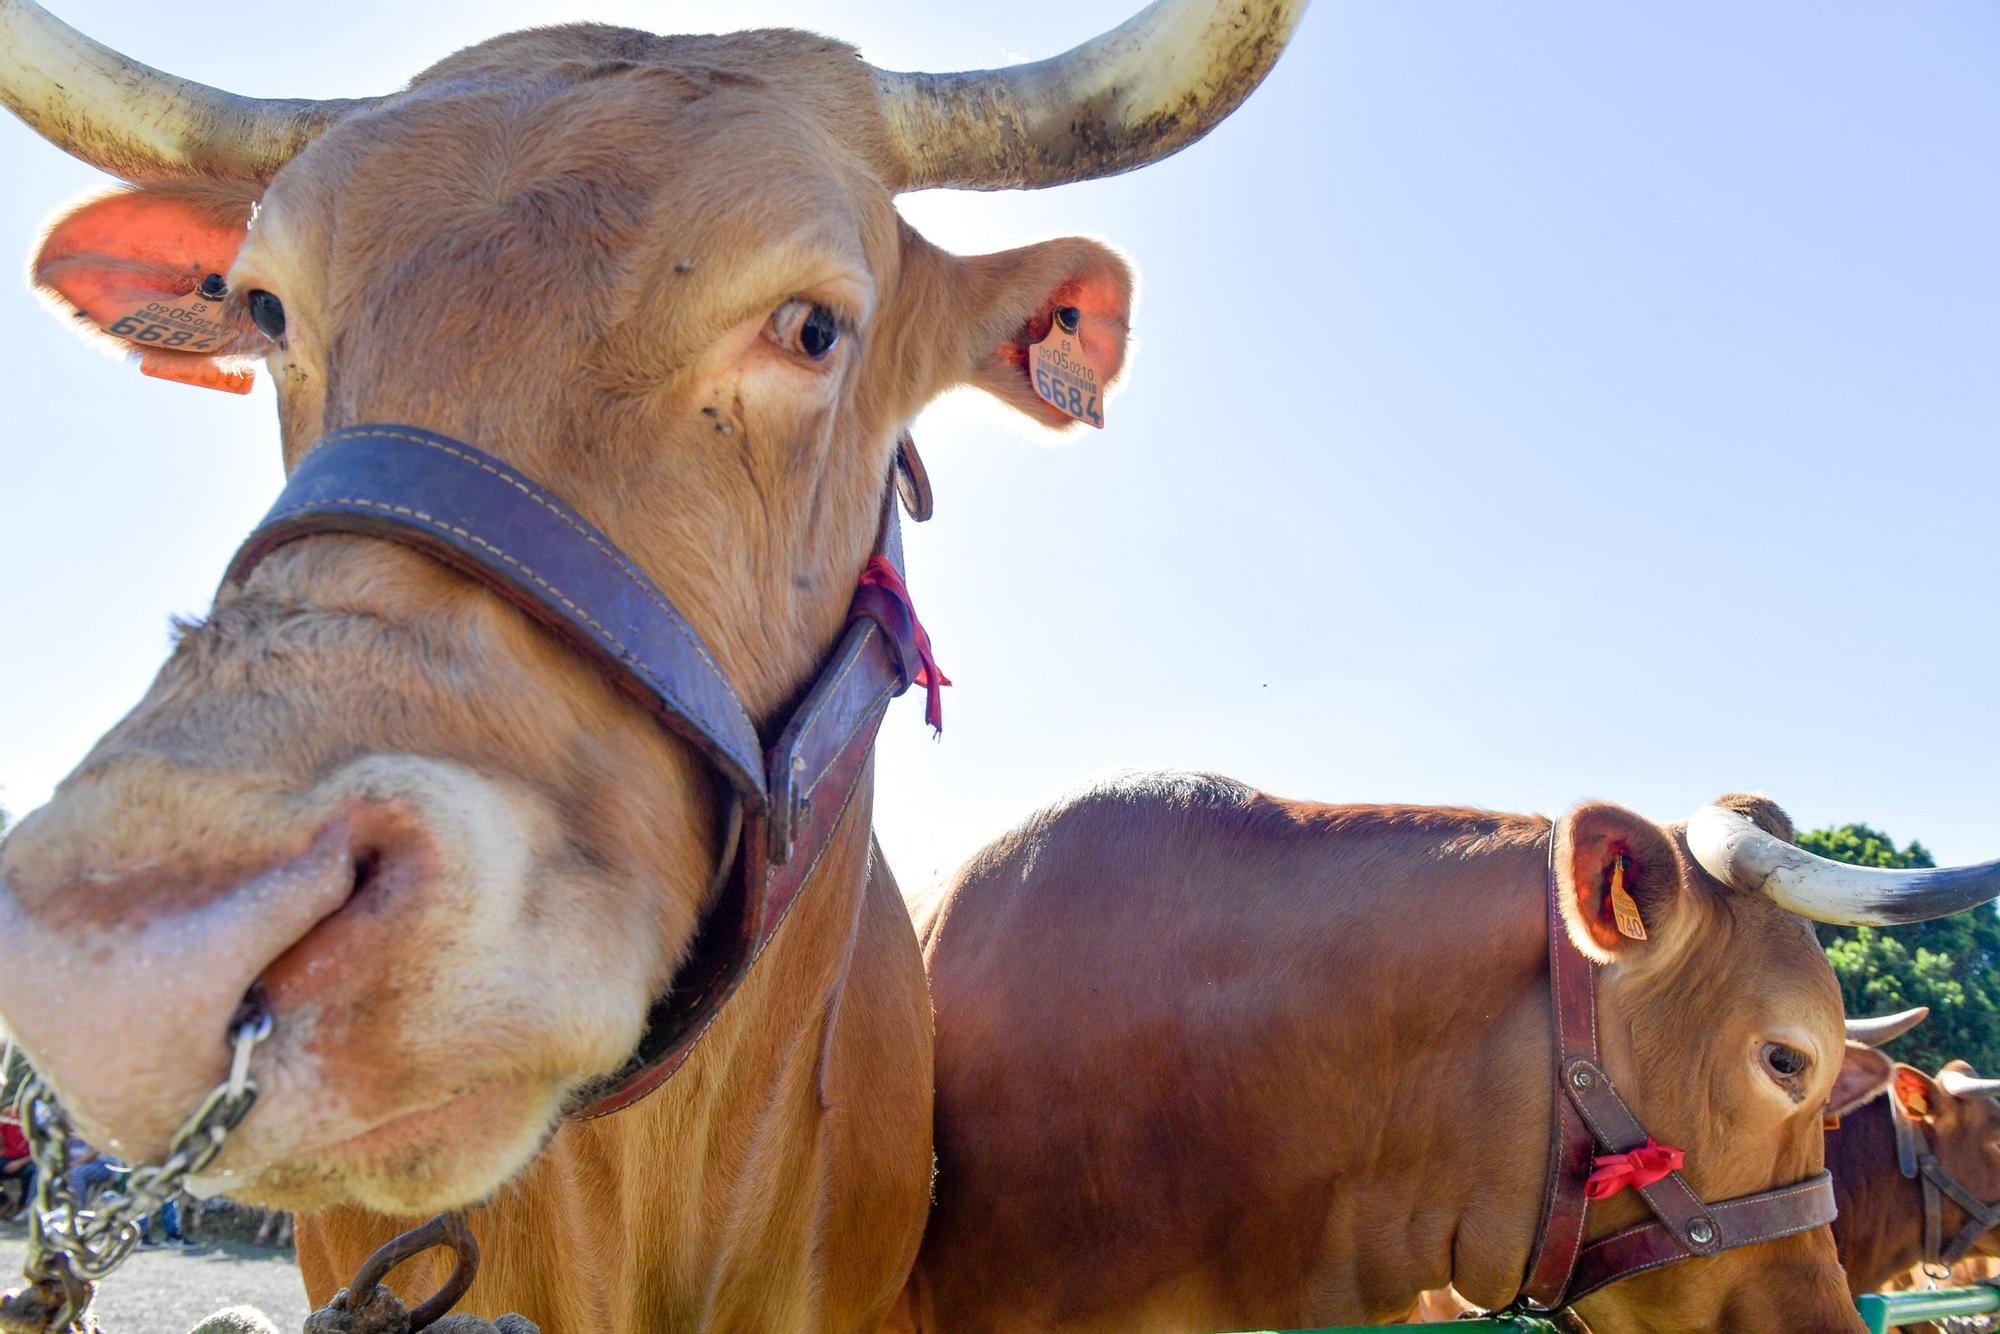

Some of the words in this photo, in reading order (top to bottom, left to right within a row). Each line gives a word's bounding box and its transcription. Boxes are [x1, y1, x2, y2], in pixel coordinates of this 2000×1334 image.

[191, 302, 208, 313] ES
[110, 316, 217, 349] 6684
[1061, 339, 1071, 352] ES
[1039, 345, 1094, 381] 09050210
[1036, 368, 1101, 425] 6684
